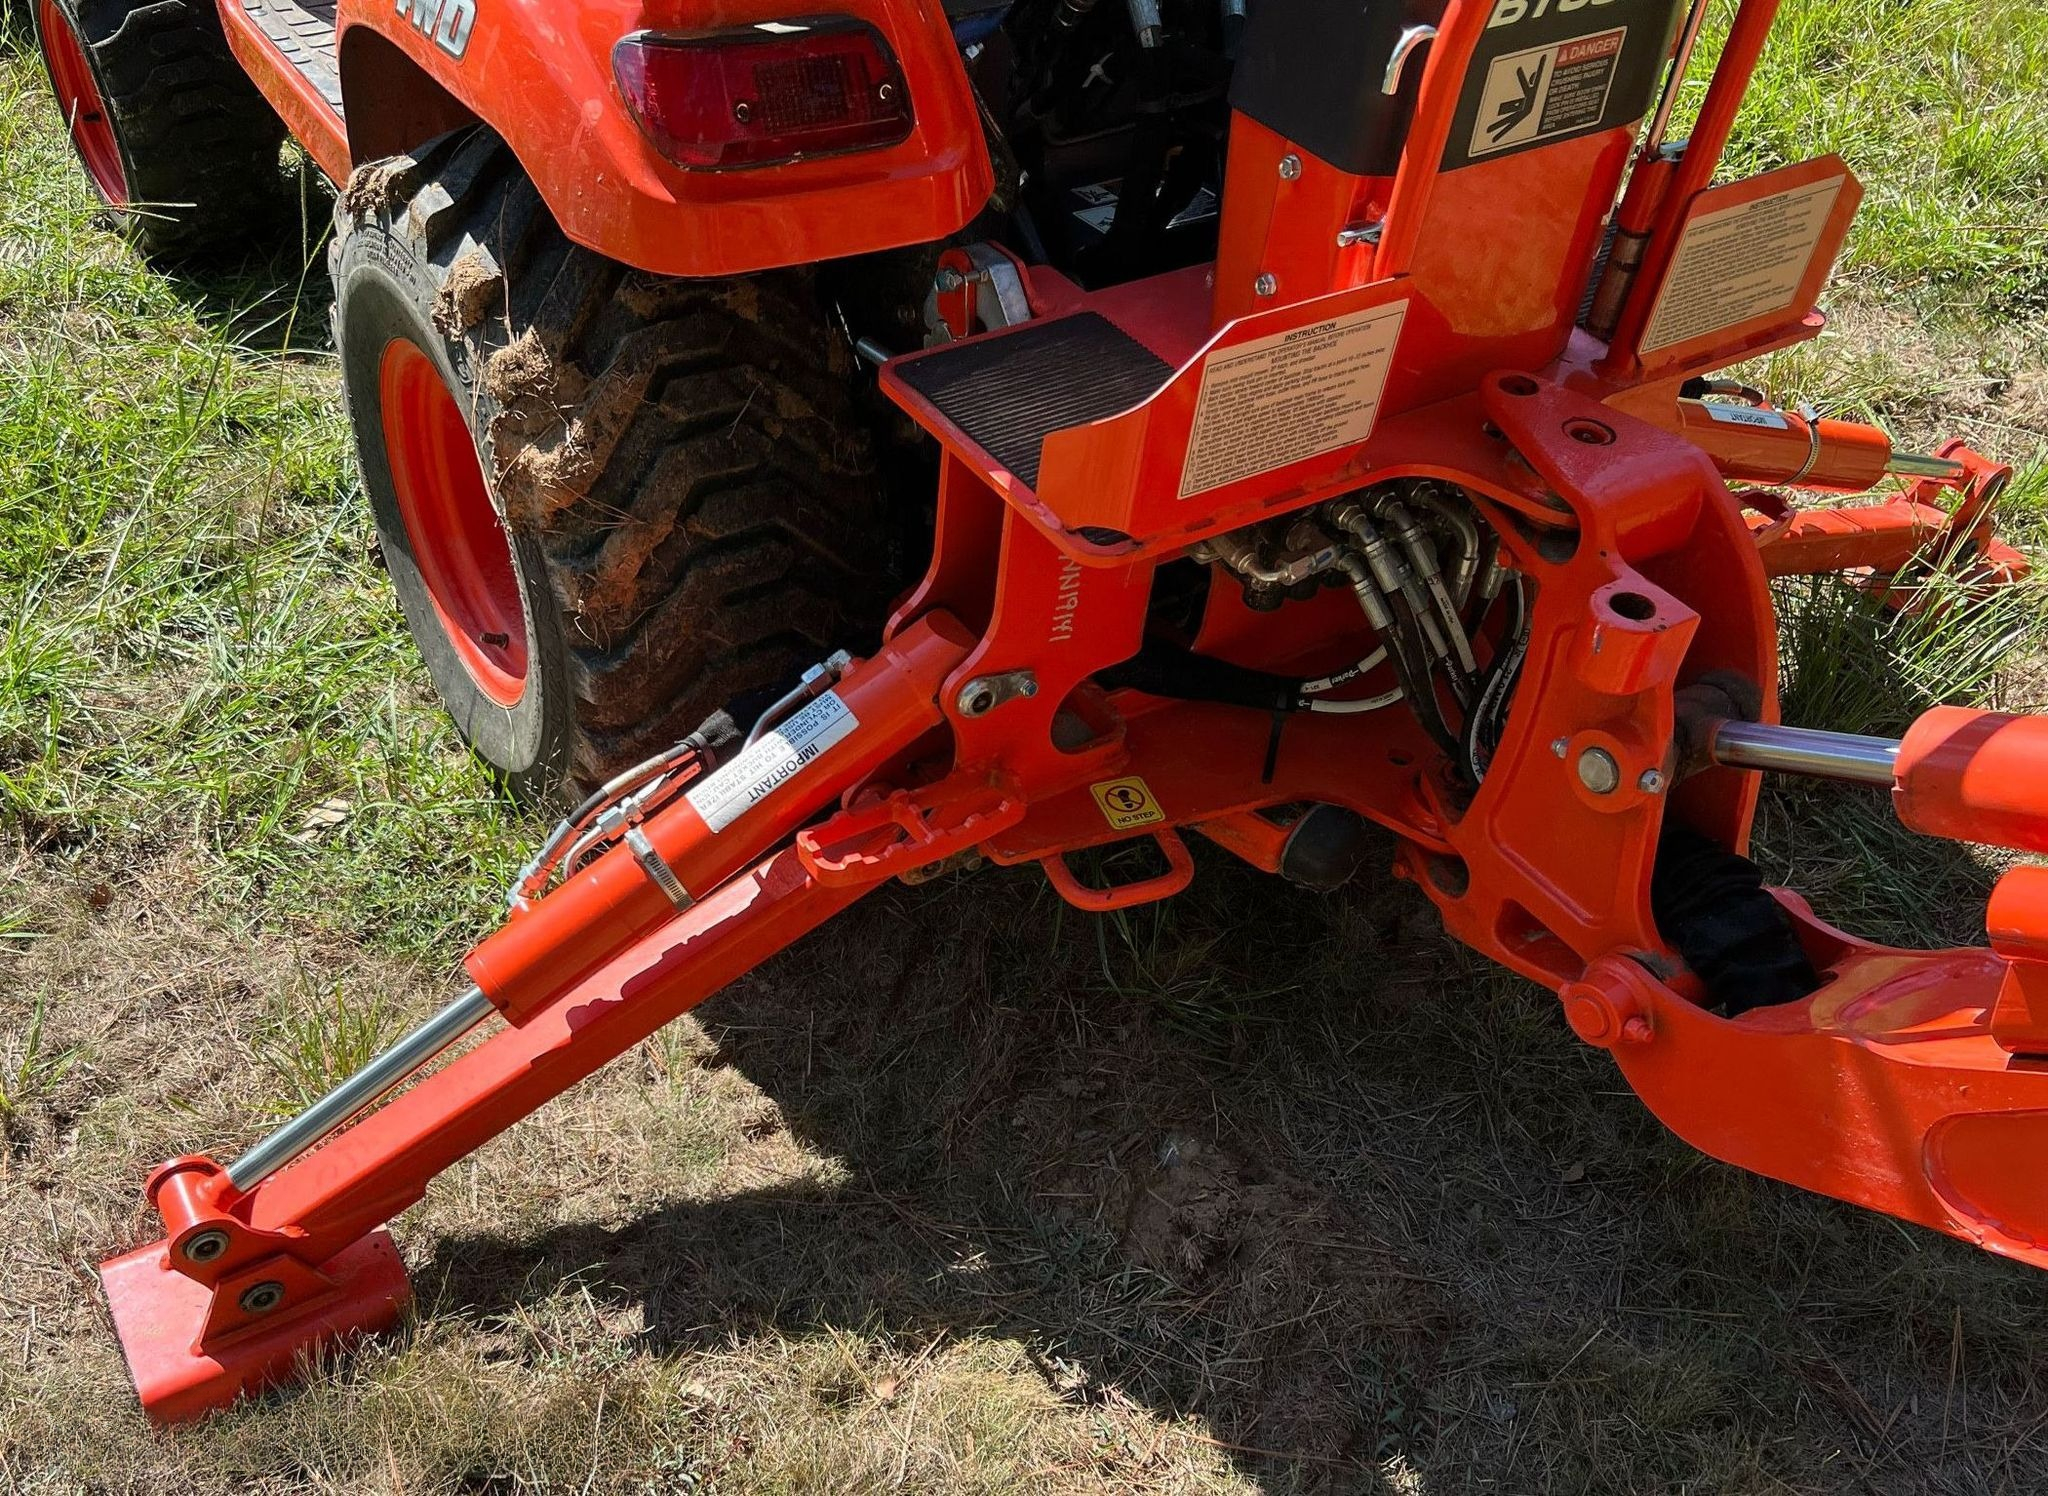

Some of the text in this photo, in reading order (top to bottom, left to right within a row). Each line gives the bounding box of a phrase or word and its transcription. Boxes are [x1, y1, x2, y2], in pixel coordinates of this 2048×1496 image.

[1569, 35, 1619, 60] DANGER
[1283, 321, 1336, 342] INSTRUCTION
[1332, 669, 1359, 684] Parker
[810, 695, 832, 712] MUST
[823, 699, 836, 710] OR
[783, 708, 823, 739] CYLINDER
[798, 711, 810, 721] BE
[699, 703, 840, 811] IT IS POSSIBLE TO HIT STABILIZER
[731, 752, 763, 778] BUCKET
[745, 743, 819, 802] IMPORTANT
[1117, 811, 1156, 824] NO STEP
